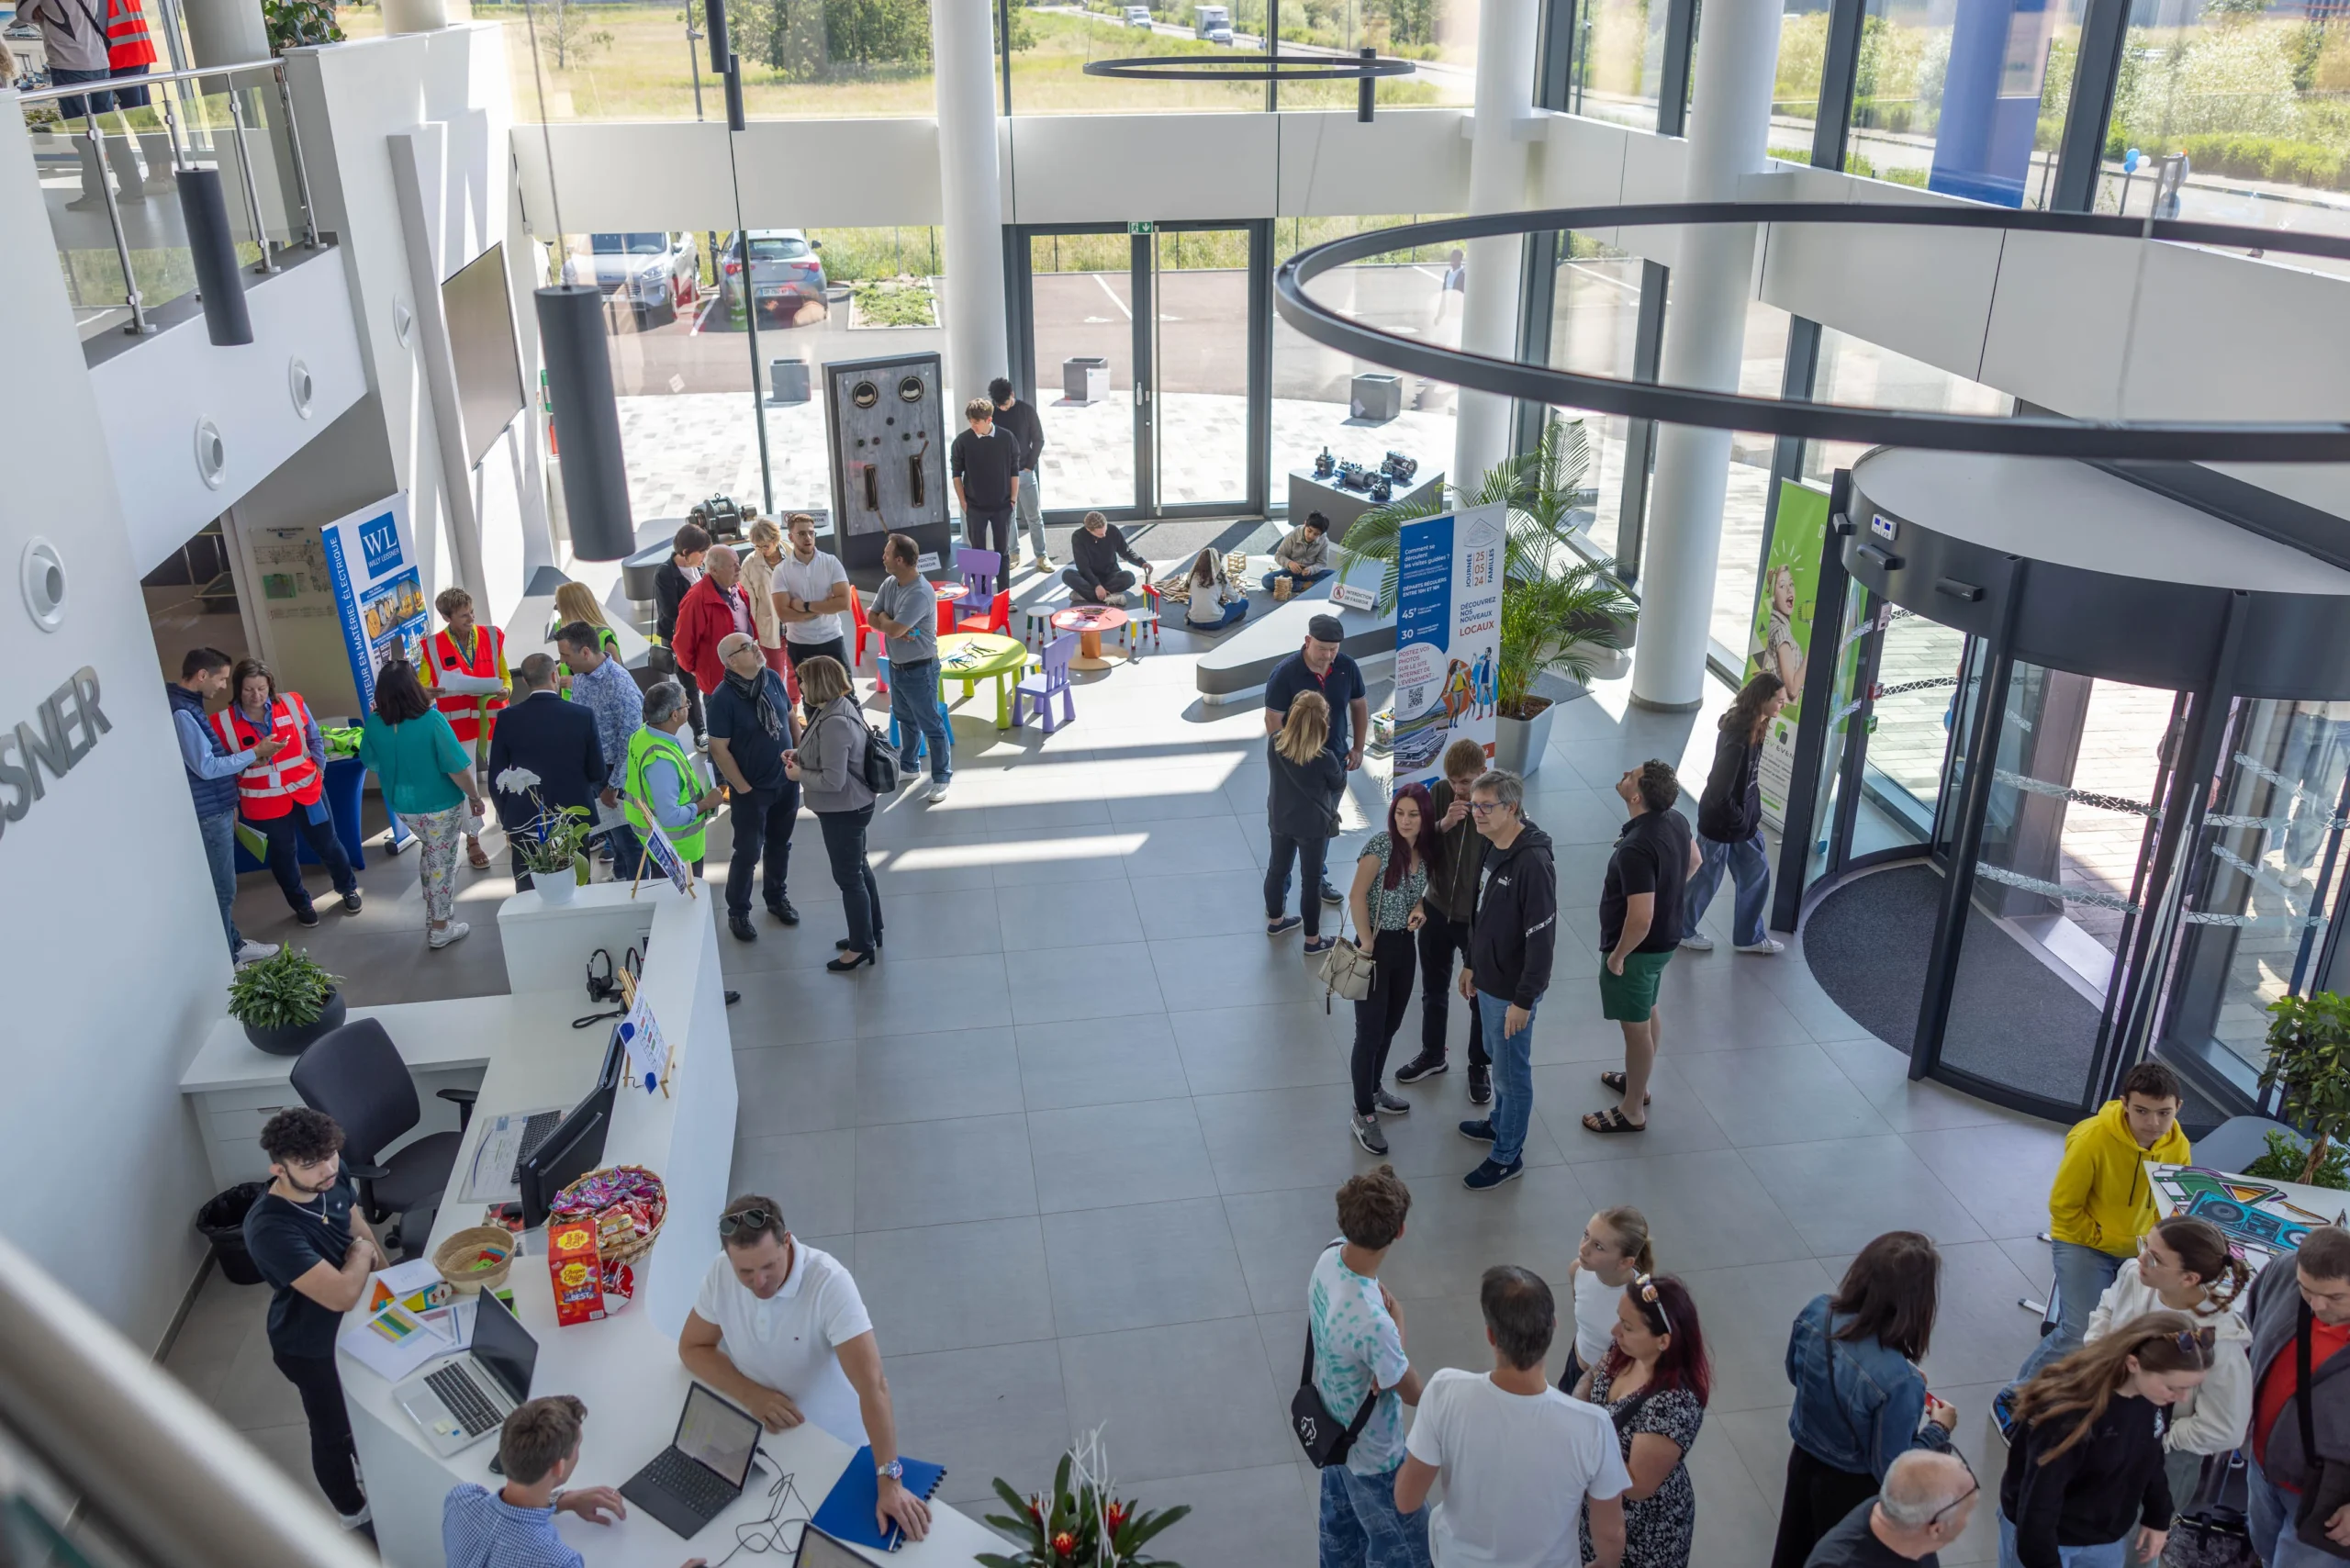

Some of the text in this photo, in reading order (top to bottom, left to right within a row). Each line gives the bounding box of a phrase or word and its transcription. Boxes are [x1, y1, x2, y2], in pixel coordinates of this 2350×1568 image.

[363, 526, 397, 556] WL
[1405, 545, 1428, 555] Comment
[368, 548, 400, 568] WILLY LEISSNER
[1404, 552, 1428, 561] déroulent
[1428, 555, 1446, 565] guidées
[1476, 551, 1485, 561] 25
[1475, 564, 1485, 574] 05
[1403, 577, 1447, 591] DÉPARTS RÉGULIERS
[1474, 576, 1484, 586] 24
[1346, 590, 1372, 600] INTERDICTION
[1460, 596, 1496, 610] DÉCOUVREZ
[1460, 609, 1473, 617] NOS
[1460, 610, 1493, 623] NOUVEAUX
[330, 537, 377, 709] BUTEUR EN MATÉRIEL ÉLECTRIQUE
[1460, 621, 1494, 637] LOCAUX
[1401, 629, 1414, 640] 30
[1399, 649, 1419, 657] POSTEZ
[1399, 655, 1420, 664] PHOTOS
[1398, 668, 1423, 679] INTERNET
[0, 666, 113, 841] SNER
[564, 1274, 585, 1283] Chups
[571, 1292, 589, 1301] BEST
